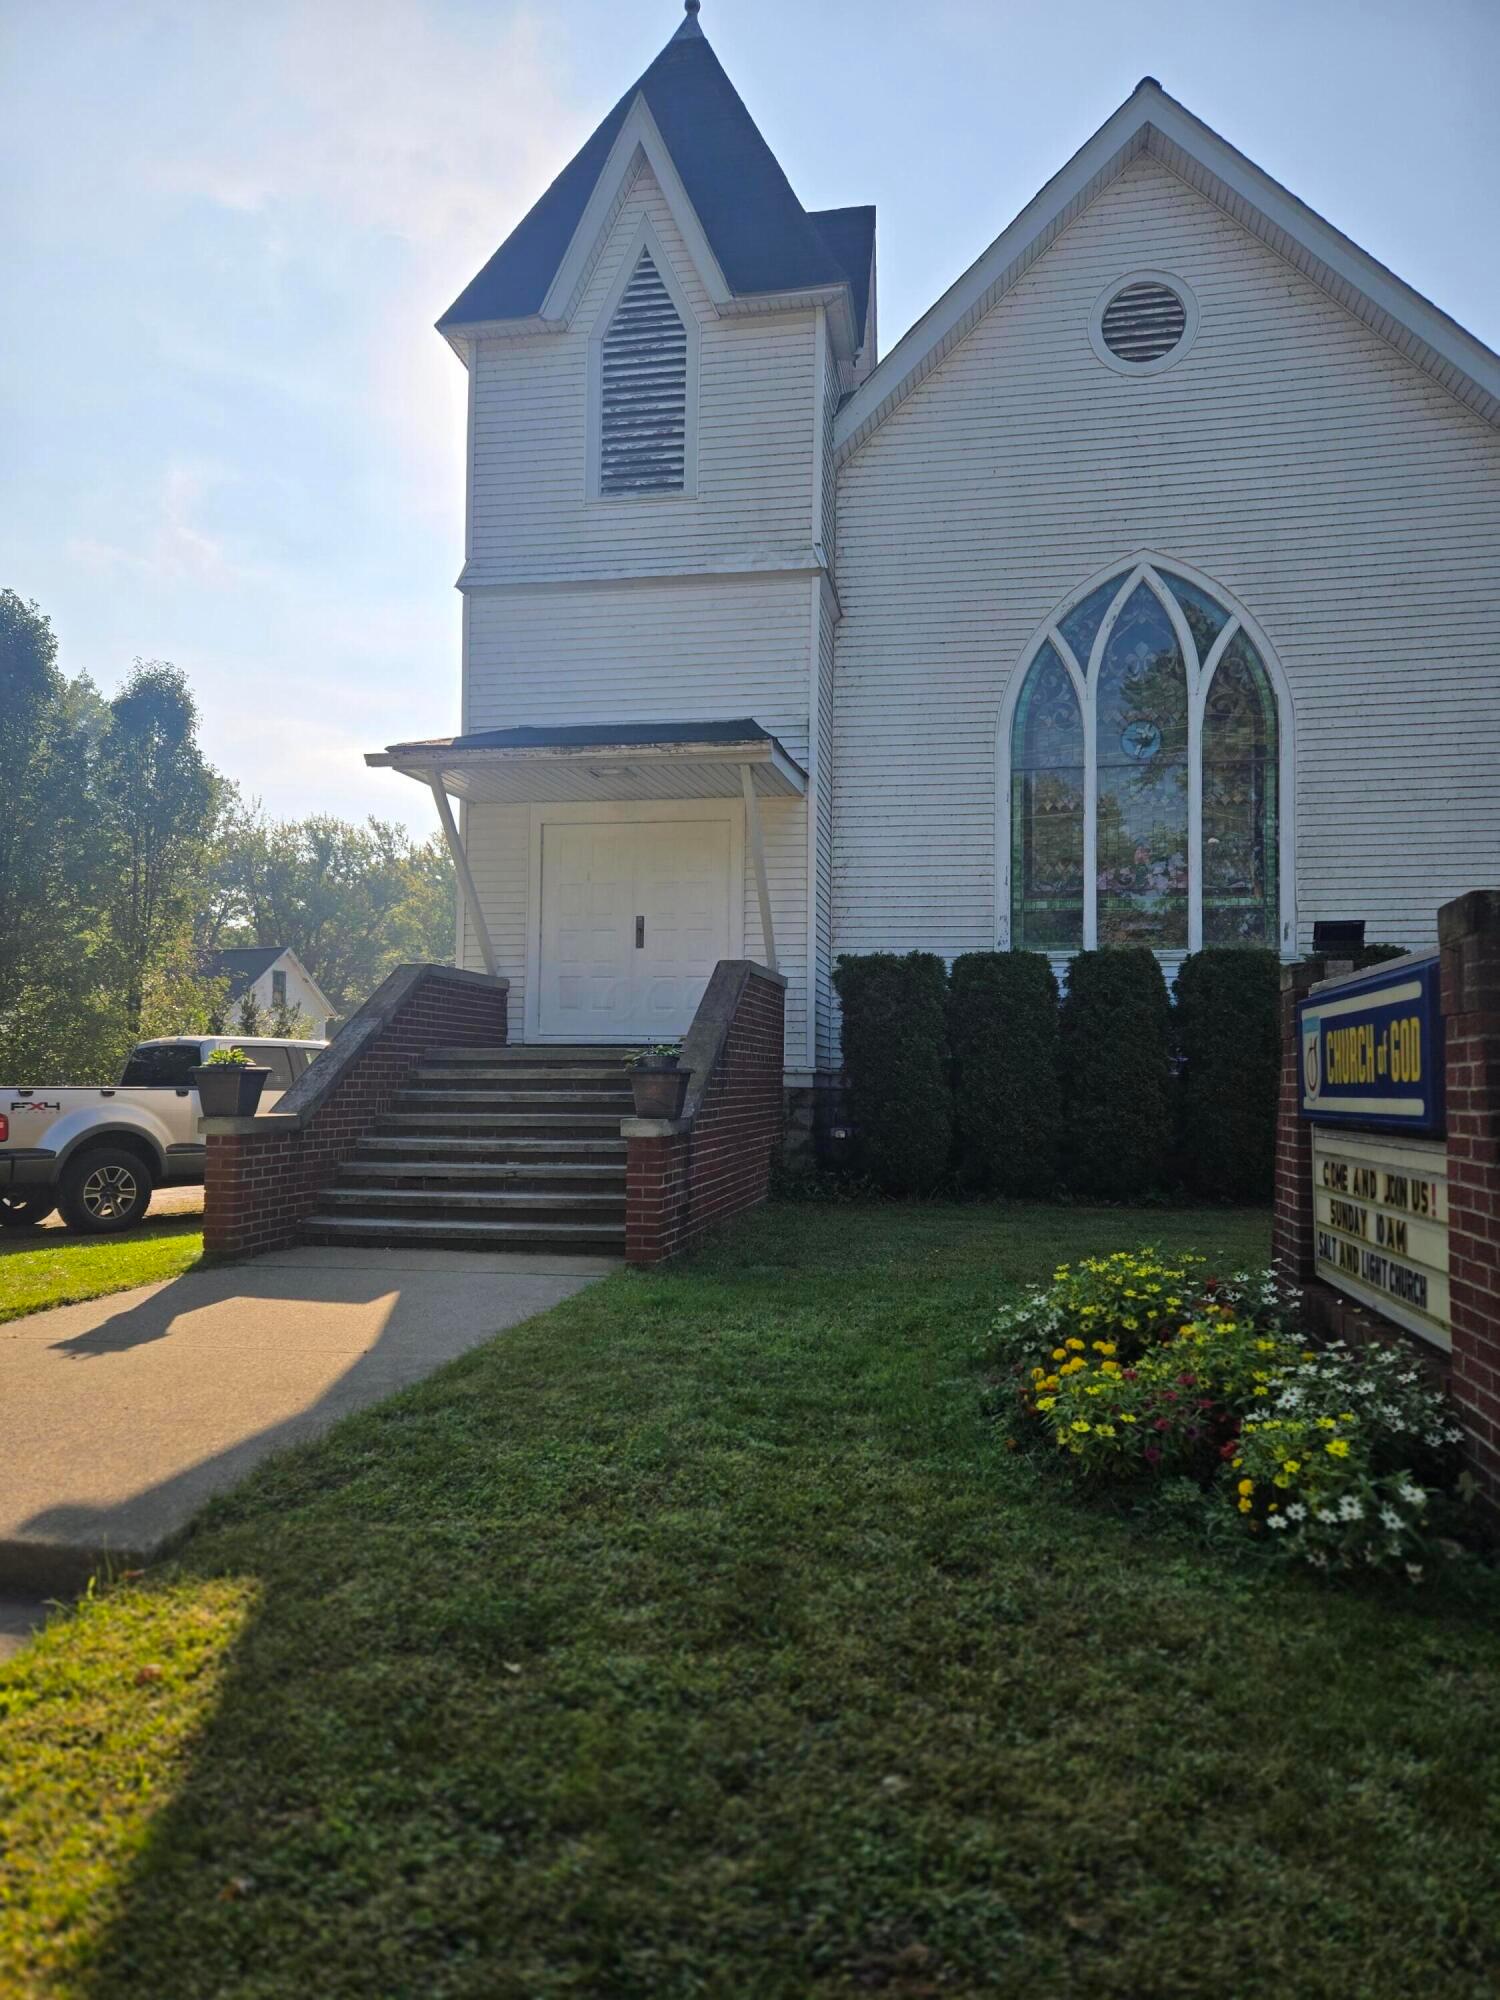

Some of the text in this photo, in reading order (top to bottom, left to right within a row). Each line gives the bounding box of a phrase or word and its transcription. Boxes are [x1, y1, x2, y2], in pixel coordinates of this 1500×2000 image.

[1327, 1017, 1421, 1084] CHURCH of GOD
[11, 1101, 60, 1111] FX4
[1323, 1161, 1348, 1191] COME
[1353, 1167, 1377, 1200] AND
[1384, 1173, 1408, 1208] JOIN
[1330, 1199, 1367, 1237] SUNDAY
[1387, 1218, 1408, 1252] AM
[1319, 1231, 1427, 1309] SALT AND LIGHT CHURCH
